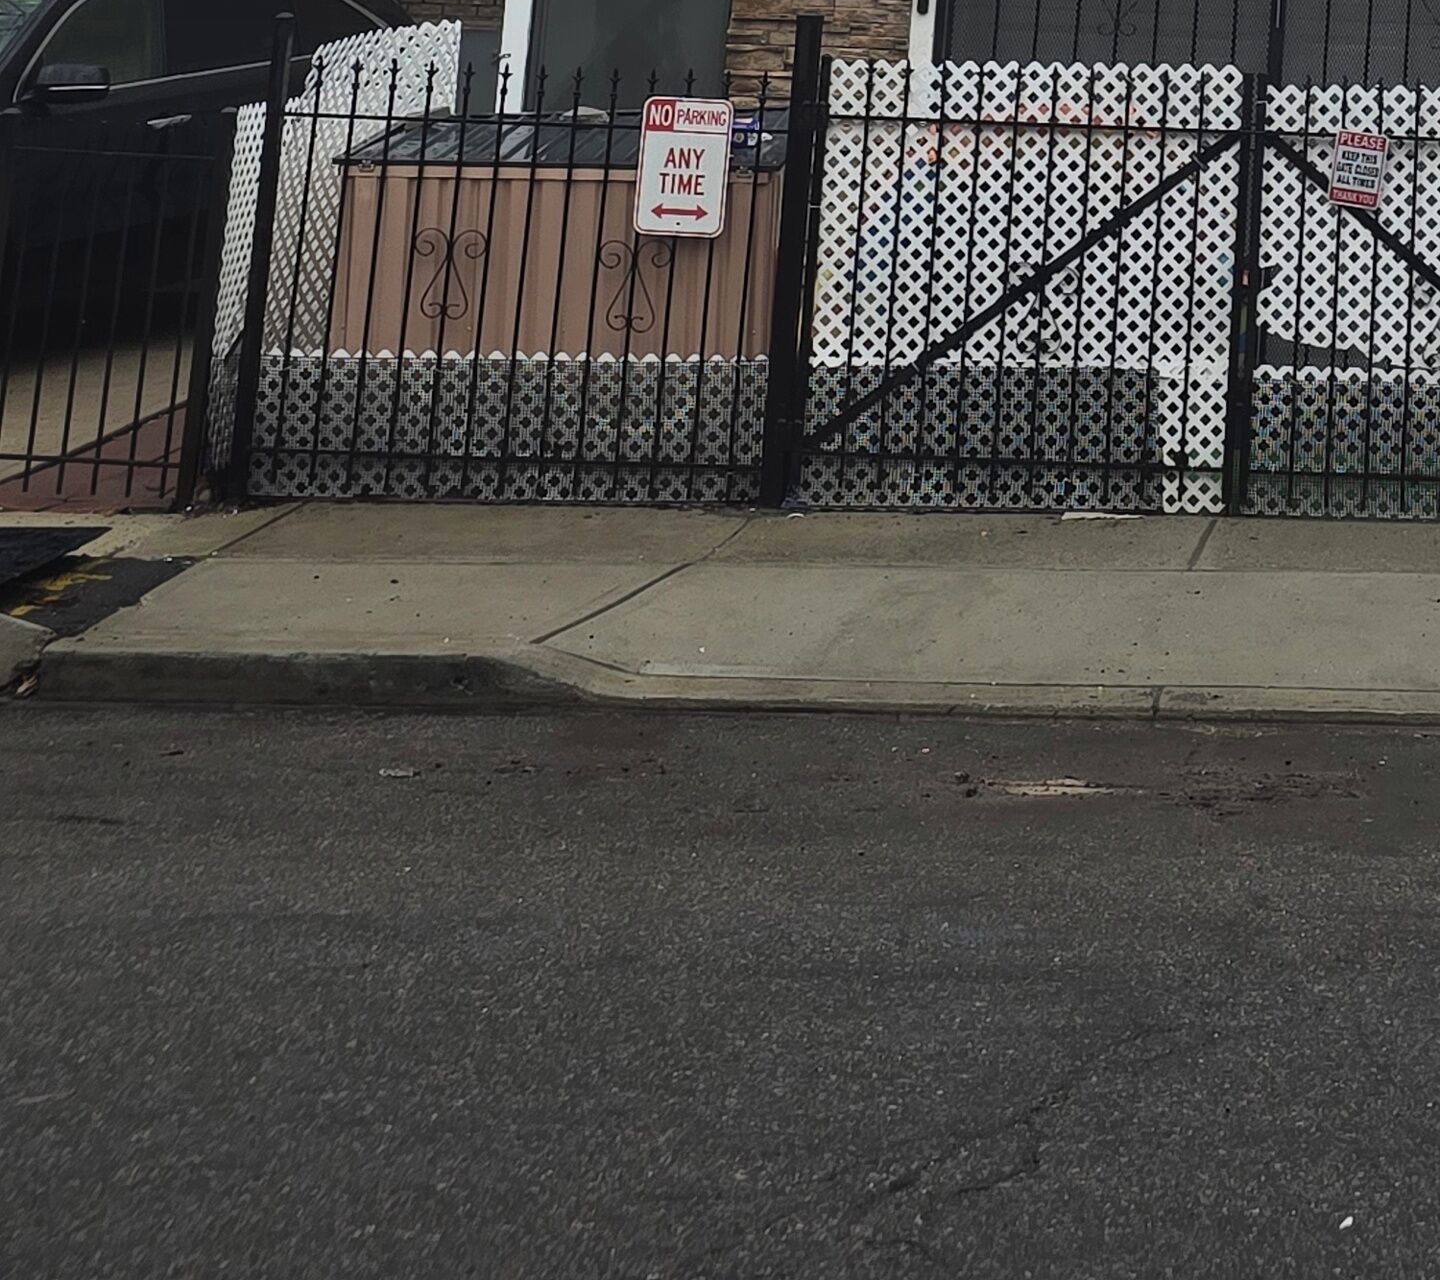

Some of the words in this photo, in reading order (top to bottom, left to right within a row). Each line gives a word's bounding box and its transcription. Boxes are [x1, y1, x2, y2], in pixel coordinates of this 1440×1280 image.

[648, 104, 673, 127] NO
[676, 108, 728, 127] PARKING
[1340, 132, 1385, 150] PLEASE
[663, 146, 706, 170] ANY
[659, 172, 706, 196] TIME
[1336, 174, 1351, 186] ALL
[1332, 188, 1359, 203] THANK
[1358, 194, 1376, 206] YOU
